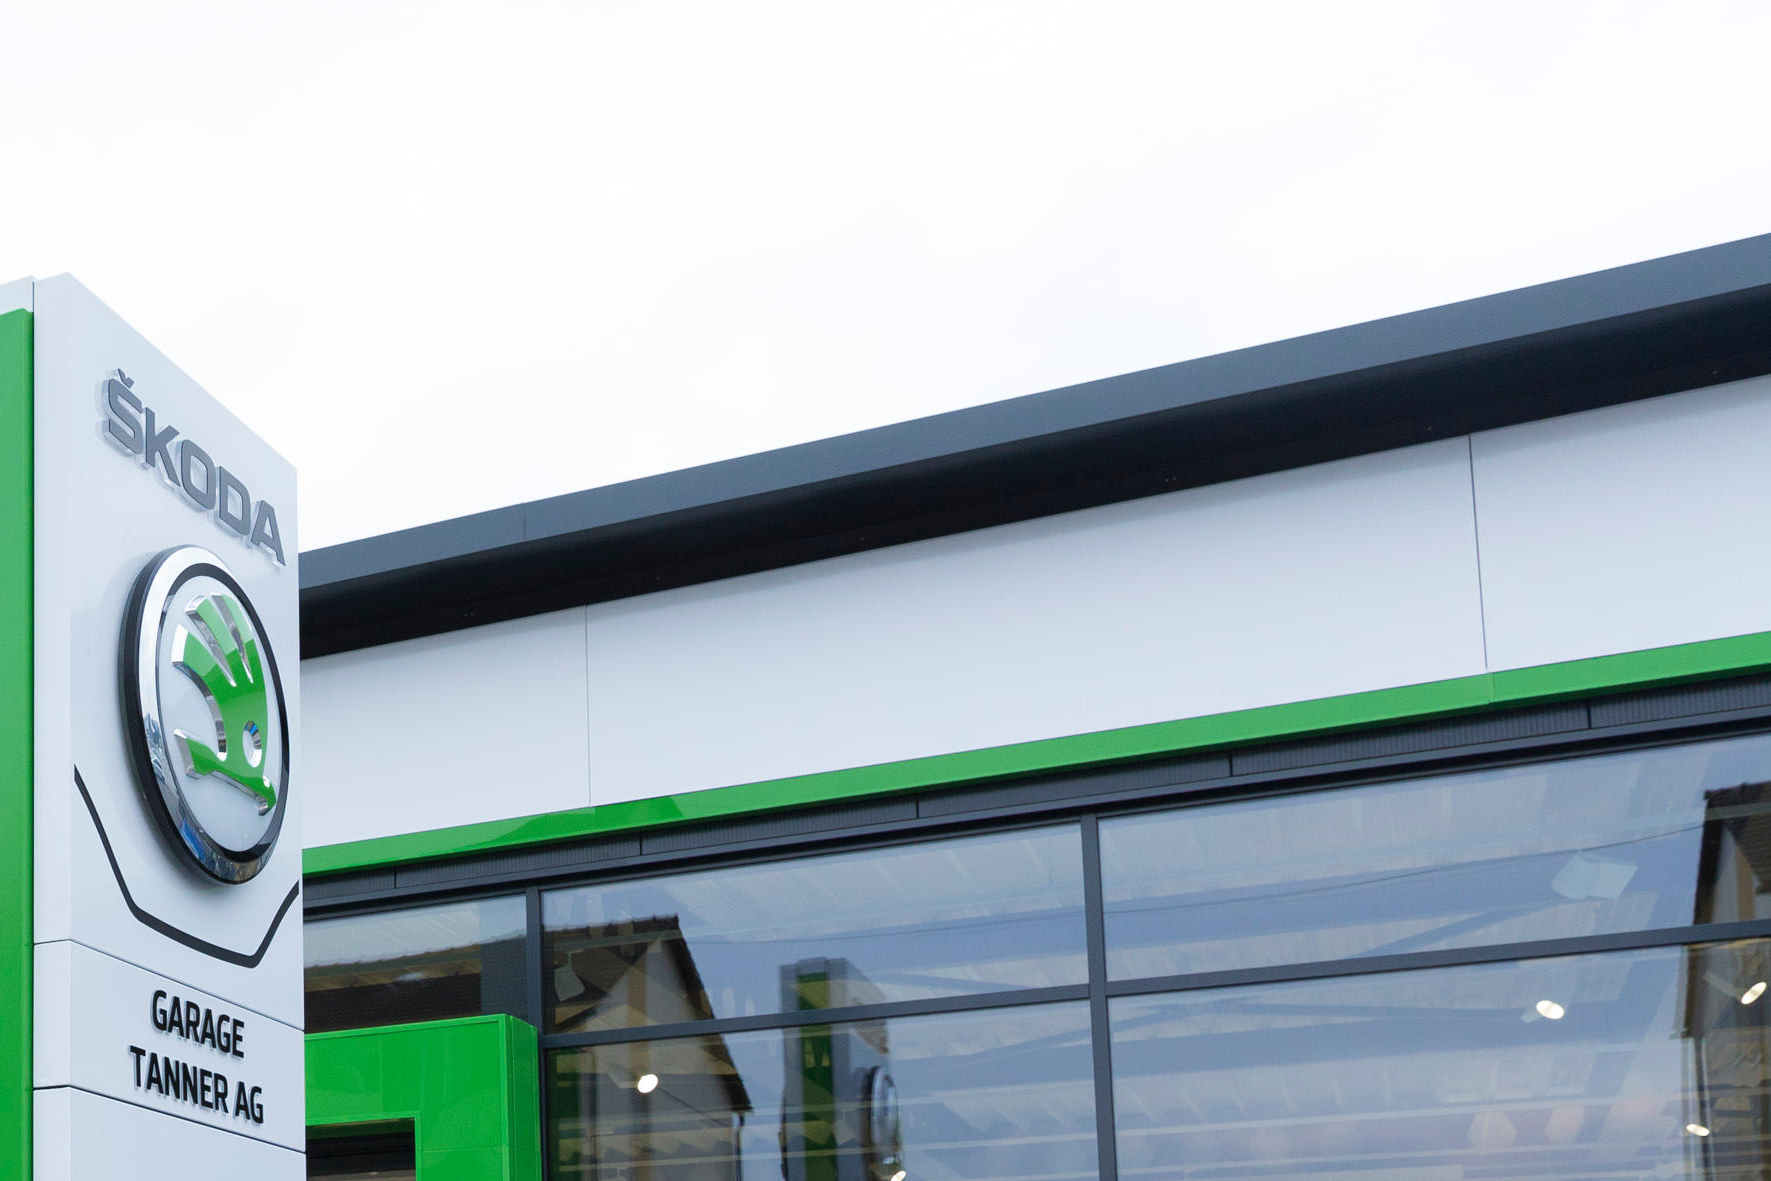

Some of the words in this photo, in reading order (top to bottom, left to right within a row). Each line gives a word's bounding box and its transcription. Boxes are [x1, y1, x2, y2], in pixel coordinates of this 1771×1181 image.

[102, 367, 286, 568] ŠKODA
[150, 989, 245, 1059] GARAGE
[128, 1045, 229, 1114] TANNER
[233, 1080, 264, 1124] AG
